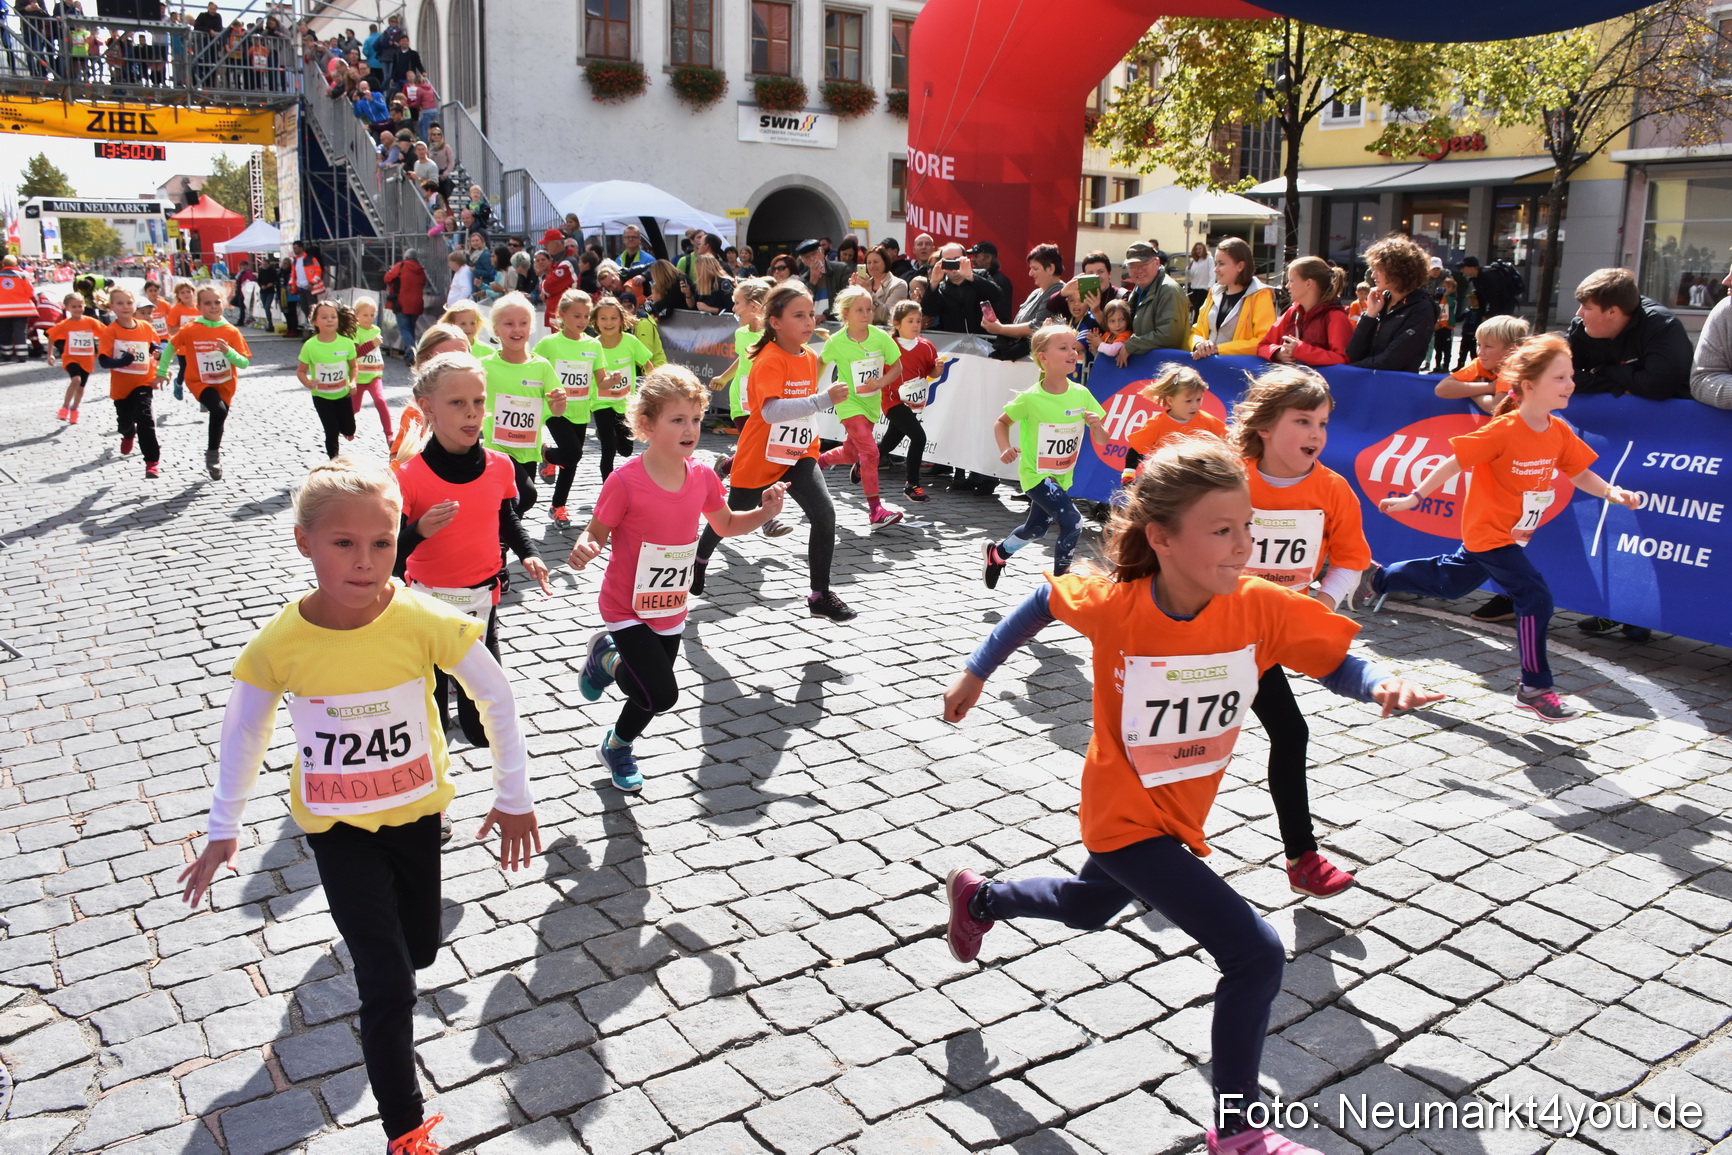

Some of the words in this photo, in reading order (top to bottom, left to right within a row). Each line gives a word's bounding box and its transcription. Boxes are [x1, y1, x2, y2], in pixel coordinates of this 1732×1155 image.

[87, 110, 158, 135] ZIEL
[760, 115, 800, 130] swn
[53, 202, 82, 212] MINI
[120, 350, 145, 362] 769
[203, 359, 226, 372] 7154
[320, 370, 344, 382] 7122
[560, 372, 588, 386] 7053
[906, 388, 926, 402] 7047
[502, 410, 534, 428] 7036
[779, 426, 812, 444] 7181
[1046, 436, 1078, 456] 7088
[1642, 452, 1723, 476] STORE
[1633, 491, 1725, 524] ONLINE
[1262, 518, 1296, 527] BOCK
[1251, 537, 1307, 564] 176
[1616, 533, 1712, 568] MOBILE
[1181, 664, 1228, 680] BOCK
[340, 701, 390, 718] BOCK
[1146, 690, 1240, 738] 7178
[315, 720, 411, 766] 7245
[1128, 732, 1138, 742] B3
[1174, 744, 1206, 760] Julia
[308, 763, 426, 801] MADLEN
